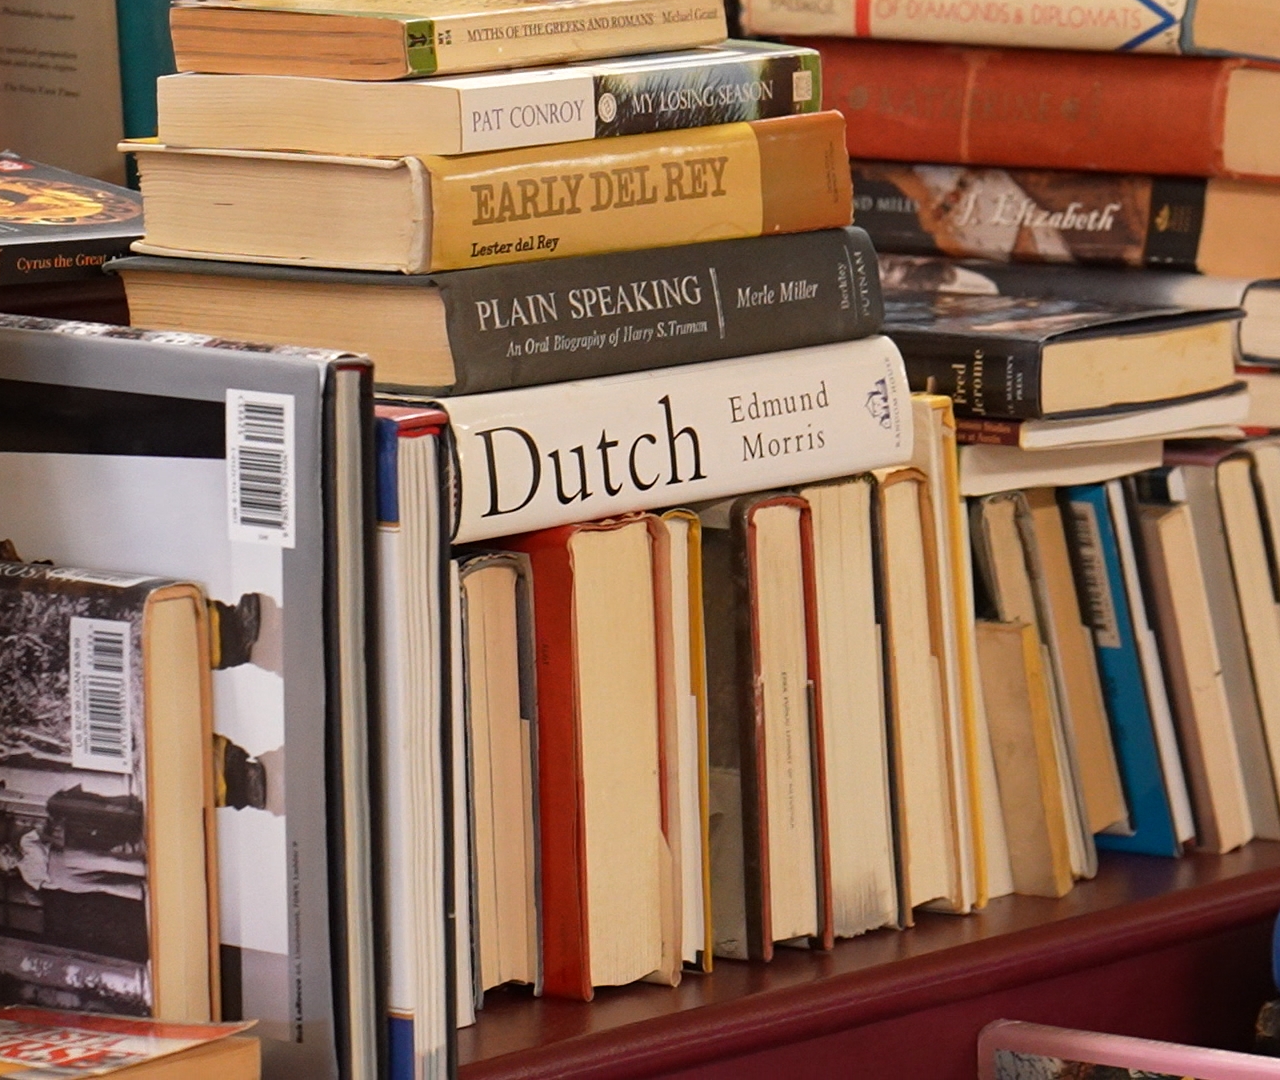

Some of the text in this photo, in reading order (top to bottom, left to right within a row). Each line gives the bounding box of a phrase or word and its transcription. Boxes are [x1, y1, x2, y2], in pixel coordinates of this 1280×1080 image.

[468, 27, 502, 43] MYTHS
[506, 25, 520, 40] OF
[521, 23, 544, 39] THE
[545, 20, 585, 38] GREEKS
[587, 18, 610, 33] AND
[611, 14, 655, 31] ROMANS
[1032, 4, 1142, 31] DIPLOMATS
[471, 98, 586, 133] PAT CONROY
[631, 79, 774, 115] MY LOSING SEASON
[471, 156, 730, 227] EARLY DEL REY
[17, 251, 106, 274] Cyrus the Great
[471, 234, 560, 258] Lester del Rey
[736, 279, 819, 308] Merle Miller
[840, 261, 851, 310] Berkley
[854, 251, 871, 317] PUTNAM
[475, 275, 703, 333] PLAIN SPEAKING
[953, 364, 968, 405] Fred
[971, 348, 986, 416] Jerome
[728, 381, 831, 424] Edmund
[474, 394, 708, 518] Dutch
[742, 426, 827, 462] Morris
